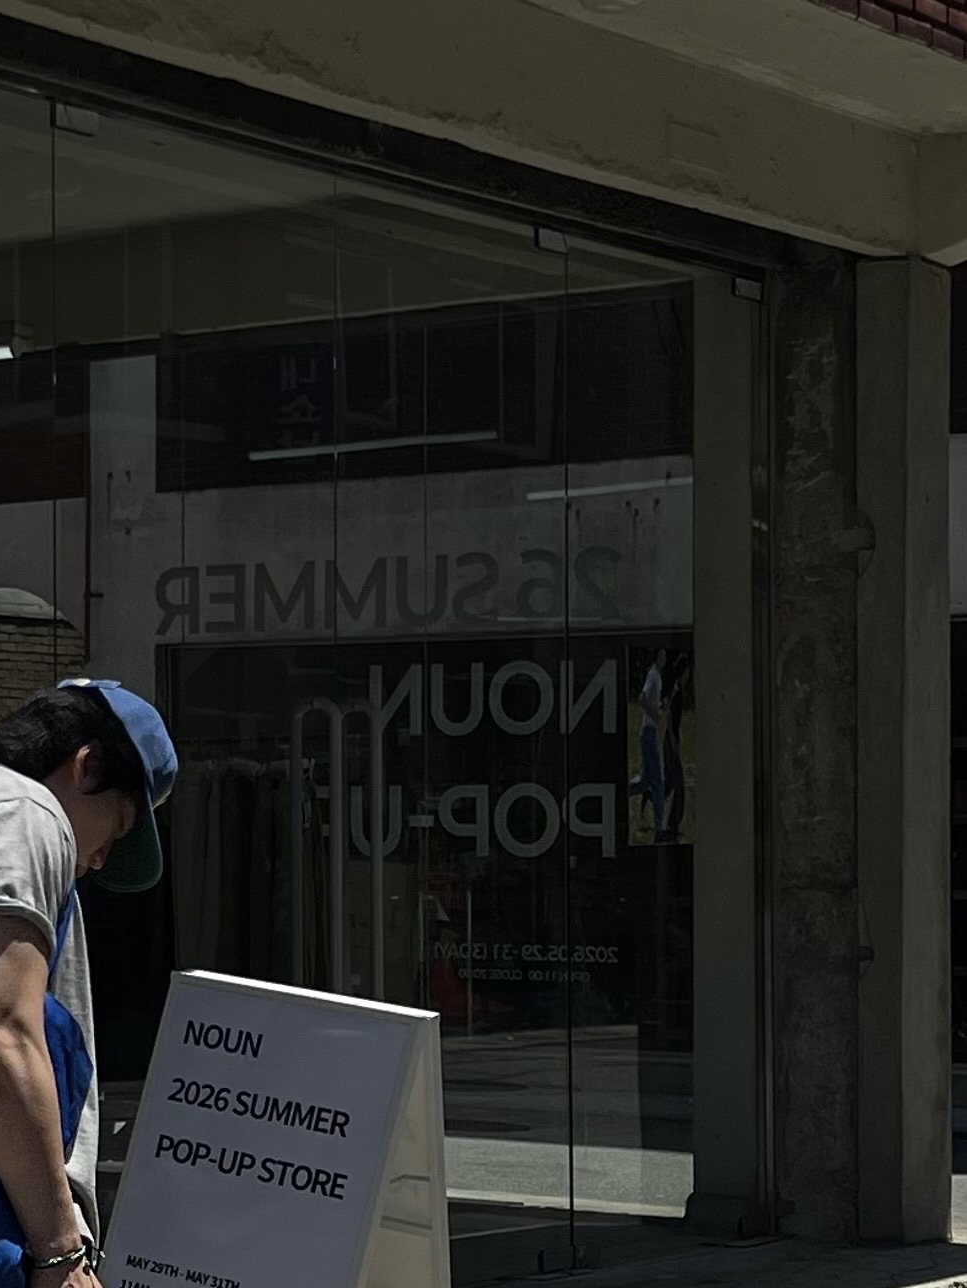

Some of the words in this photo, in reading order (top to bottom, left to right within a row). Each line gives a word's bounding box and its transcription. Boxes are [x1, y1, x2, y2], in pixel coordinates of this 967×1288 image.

[183, 1019, 263, 1058] NOUN
[167, 1077, 230, 1113] 2026
[232, 1090, 351, 1138] SUMMER
[154, 1133, 257, 1178] POP-UP
[257, 1156, 349, 1201] STORE
[125, 1254, 150, 1270] MAY
[150, 1260, 179, 1278] 29TH
[185, 1268, 210, 1286] MAY
